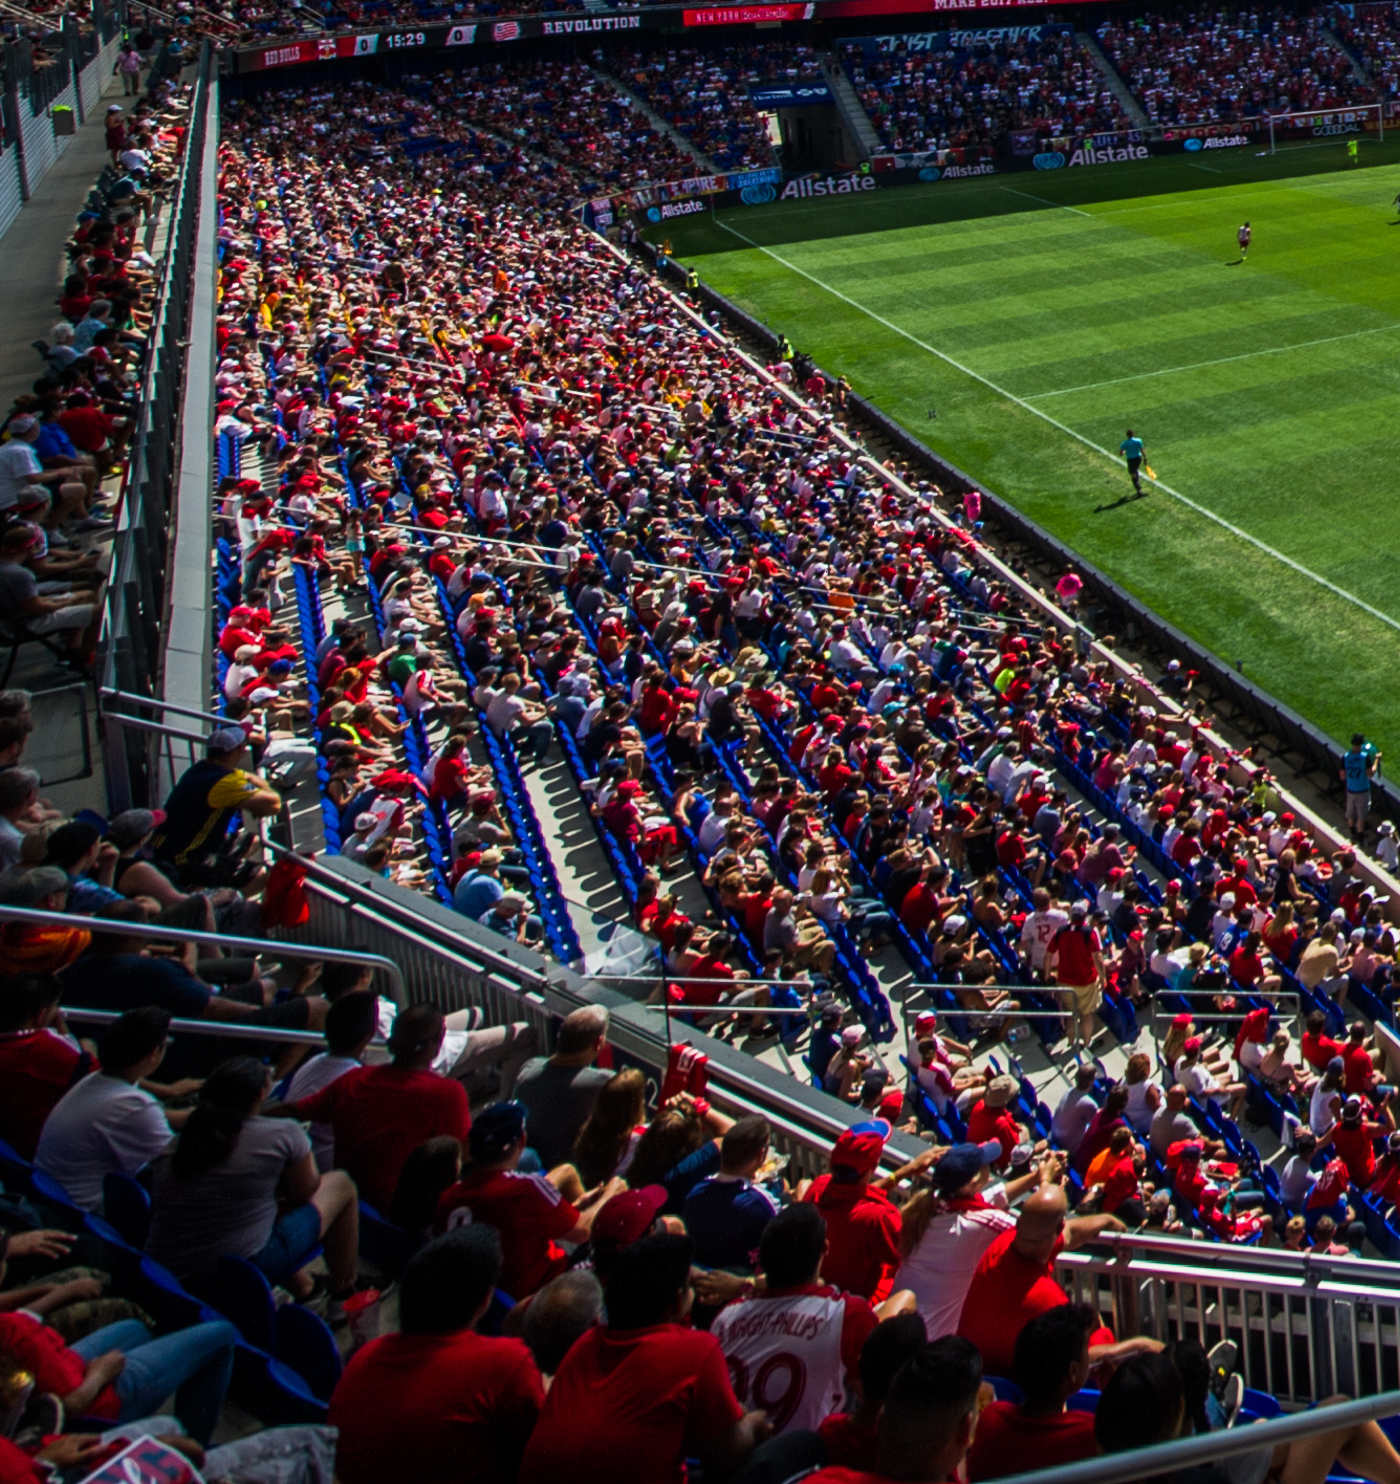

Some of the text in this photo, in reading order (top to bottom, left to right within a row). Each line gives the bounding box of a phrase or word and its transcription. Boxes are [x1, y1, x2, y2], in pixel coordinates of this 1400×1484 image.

[542, 16, 641, 34] REVOLUTION
[386, 32, 427, 48] 15:29
[454, 29, 462, 42] 0
[361, 38, 369, 52] 0
[1203, 134, 1249, 149] Allstate
[1068, 144, 1149, 167] Allstate
[941, 163, 996, 179] Allstate
[781, 173, 876, 200] Allstate
[661, 199, 706, 219] Allstate
